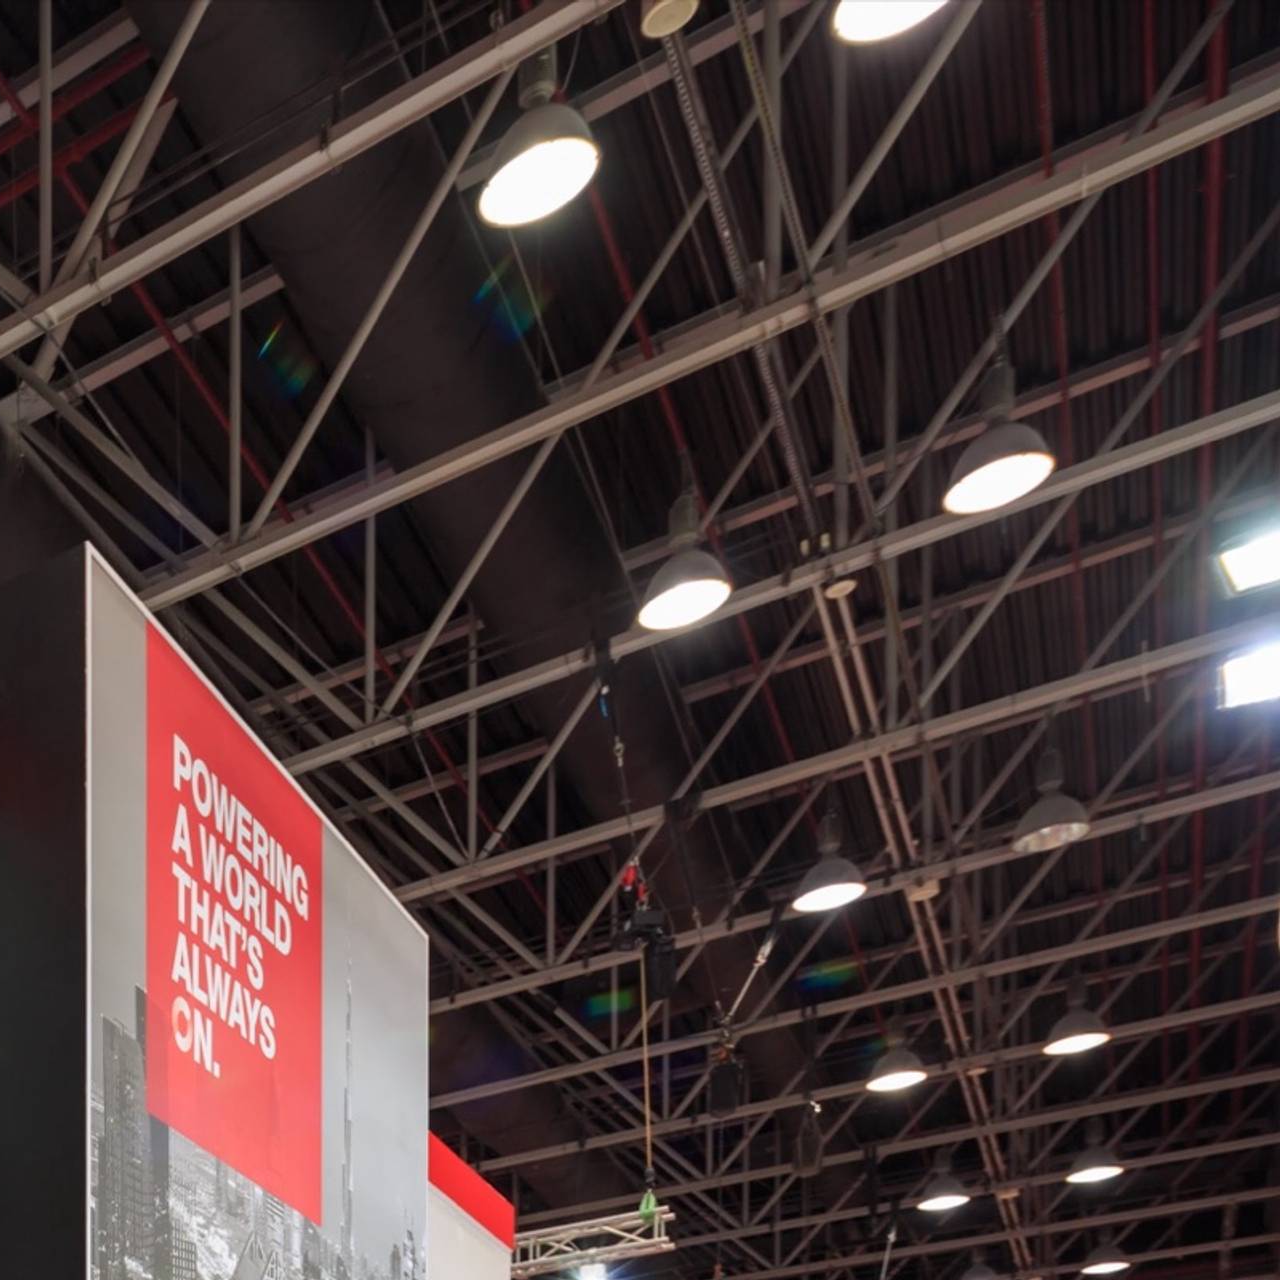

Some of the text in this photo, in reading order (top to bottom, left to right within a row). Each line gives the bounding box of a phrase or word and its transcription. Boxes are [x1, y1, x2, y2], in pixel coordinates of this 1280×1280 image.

[172, 803, 292, 957] A WORLD
[173, 732, 309, 921] POWERING
[172, 861, 264, 991] THAT'S
[172, 931, 276, 1061] ALWAYS
[172, 996, 221, 1079] ON.
